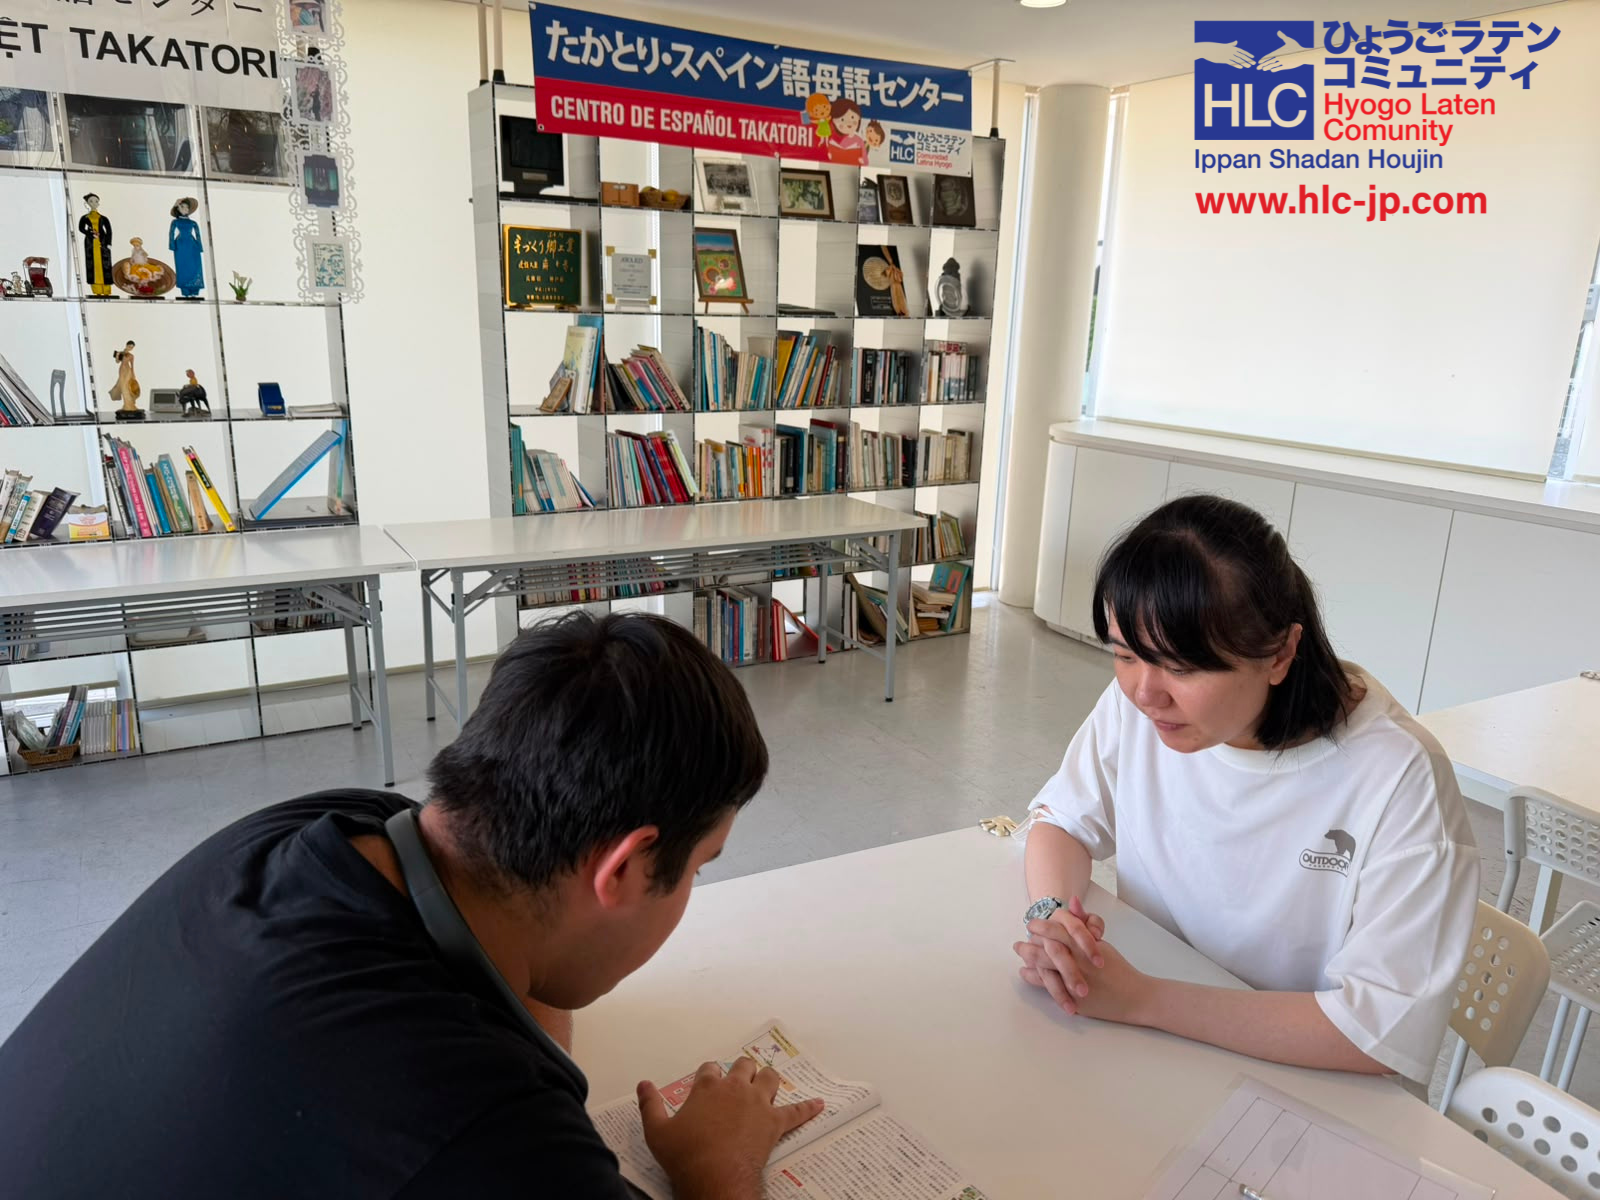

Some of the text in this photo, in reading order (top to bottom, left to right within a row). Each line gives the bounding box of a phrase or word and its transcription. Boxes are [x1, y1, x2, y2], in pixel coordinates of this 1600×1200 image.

[69, 26, 278, 79] TAKATORI
[546, 19, 964, 111] たかとり・スペイン語母語センター
[551, 95, 813, 147] CENTRO DE ESPAÑOL TAKATORI
[890, 145, 914, 161] HLC
